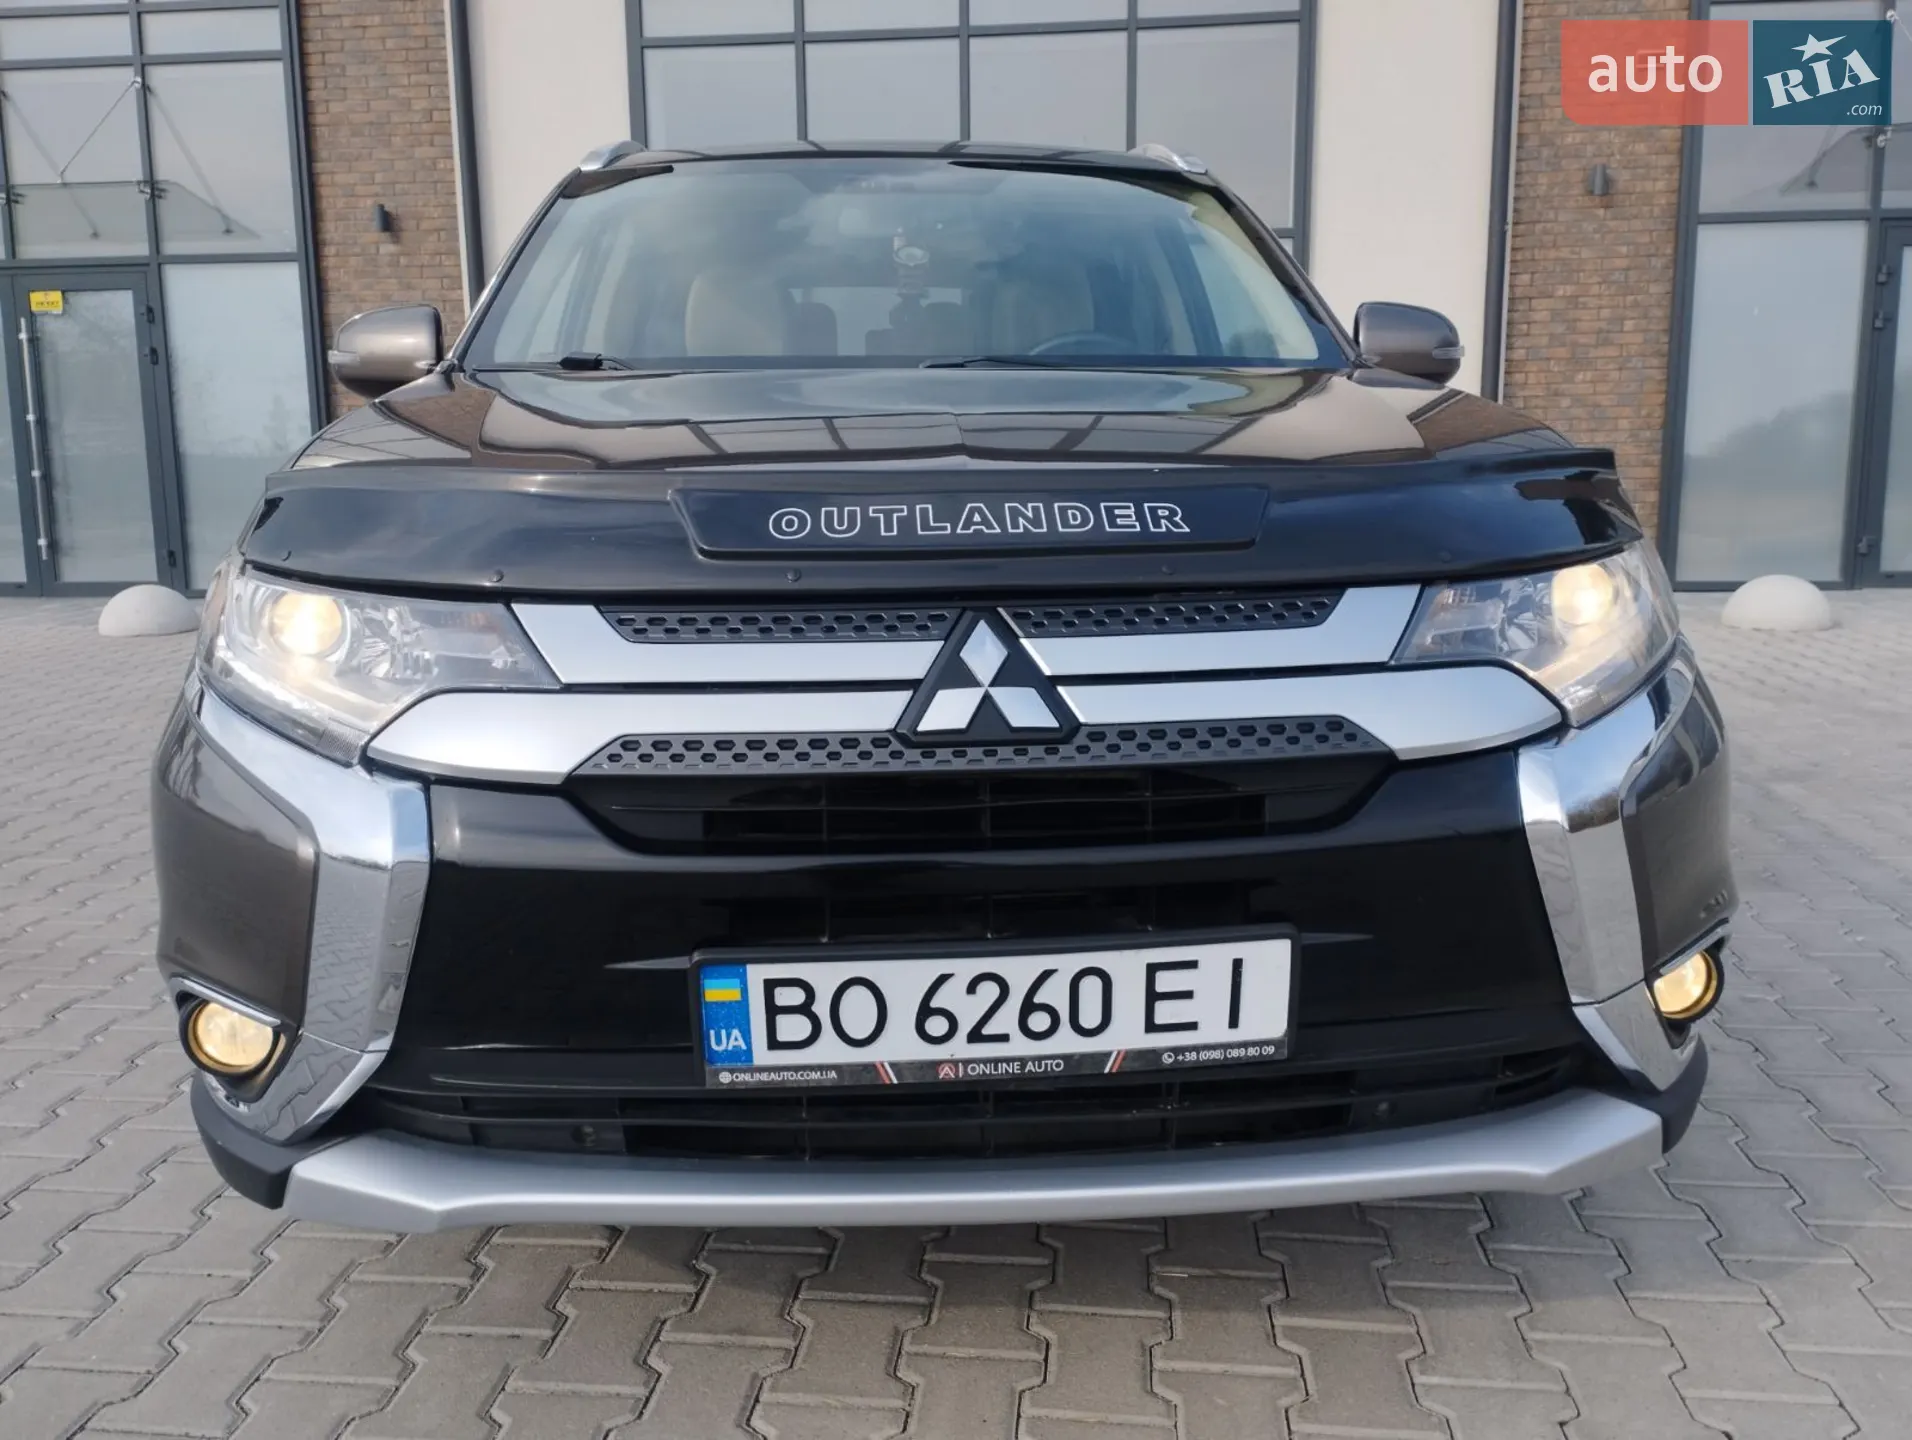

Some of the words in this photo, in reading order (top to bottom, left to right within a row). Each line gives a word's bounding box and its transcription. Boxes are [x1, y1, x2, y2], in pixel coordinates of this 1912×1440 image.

[768, 501, 1191, 539] OUTLANDER
[762, 975, 888, 1051] BO
[913, 965, 1113, 1046] 6260
[709, 1028, 747, 1051] UA
[1176, 1051, 1197, 1062] +38
[1226, 1047, 1246, 1058] 089
[1261, 1044, 1275, 1055] 09
[967, 1061, 1021, 1076] ONLINE
[1024, 1059, 1065, 1073] AUTO
